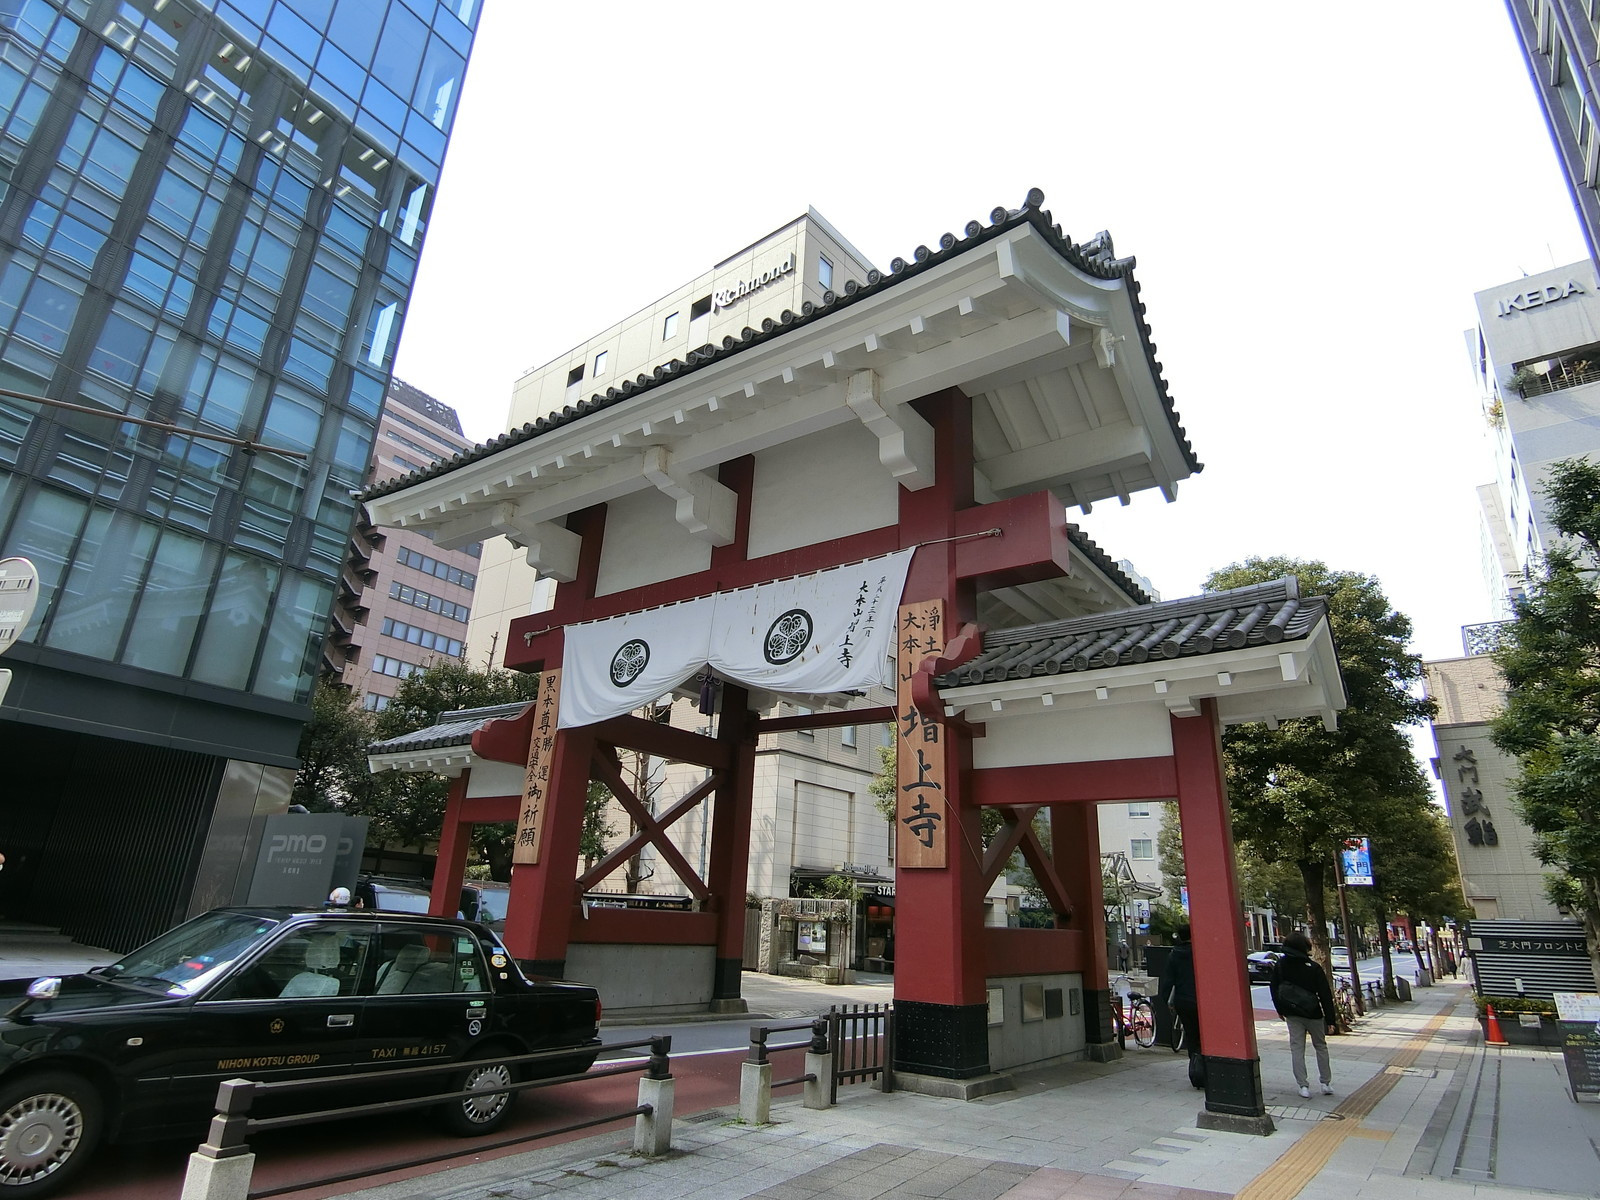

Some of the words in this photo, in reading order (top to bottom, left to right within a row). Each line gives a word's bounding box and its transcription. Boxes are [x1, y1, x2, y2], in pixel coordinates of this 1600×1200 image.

[711, 252, 795, 314] Richmond
[1498, 279, 1586, 317] IKEDA
[1344, 861, 1370, 874] 大門
[1498, 940, 1584, 952] 芝大門フロントビ
[372, 1048, 397, 1059] TAXI
[421, 1044, 447, 1055] 4157
[217, 1058, 251, 1070] NIHON
[252, 1056, 286, 1067] KOTSU
[287, 1054, 320, 1065] GROUP
